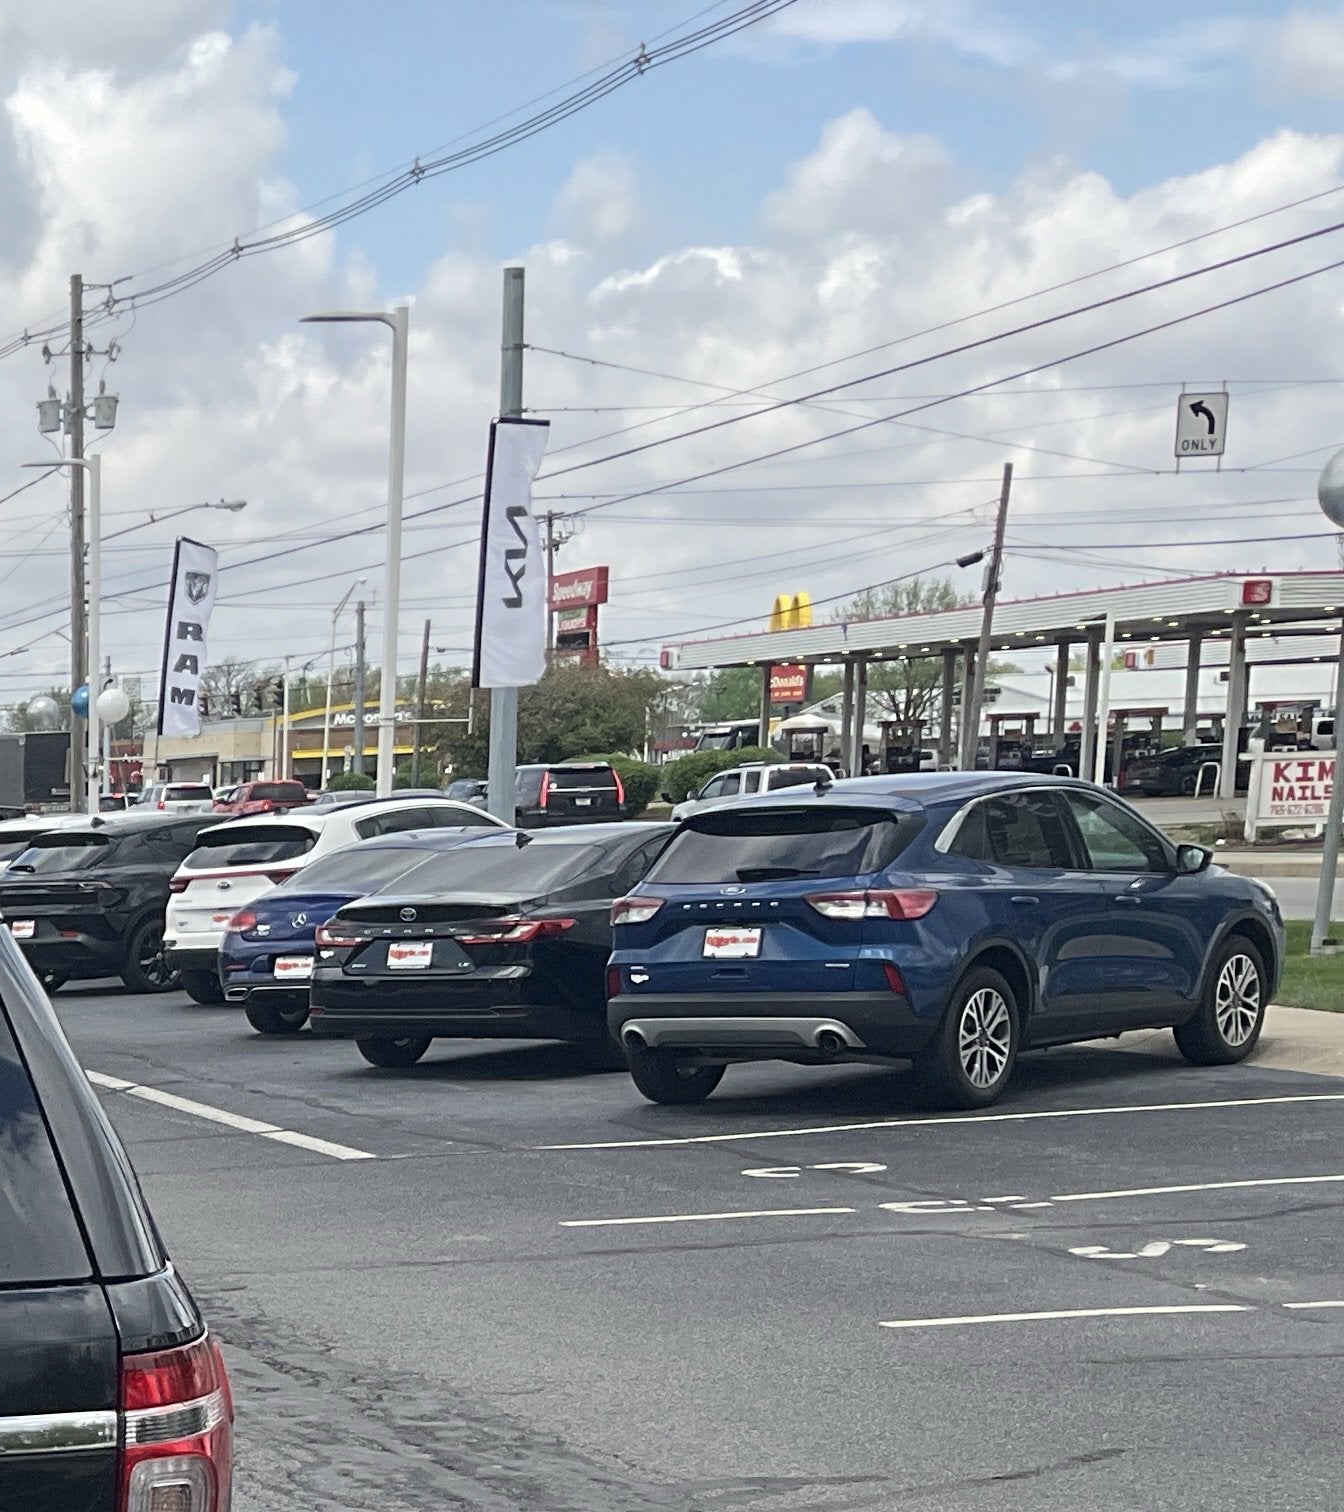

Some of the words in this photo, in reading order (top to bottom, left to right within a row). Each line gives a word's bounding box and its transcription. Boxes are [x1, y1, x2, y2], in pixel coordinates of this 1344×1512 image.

[1181, 438, 1218, 451] ONLY
[553, 579, 593, 605] Speedway
[170, 620, 203, 707] RAM
[1273, 760, 1336, 783] KIM
[1271, 784, 1333, 801] NAILS
